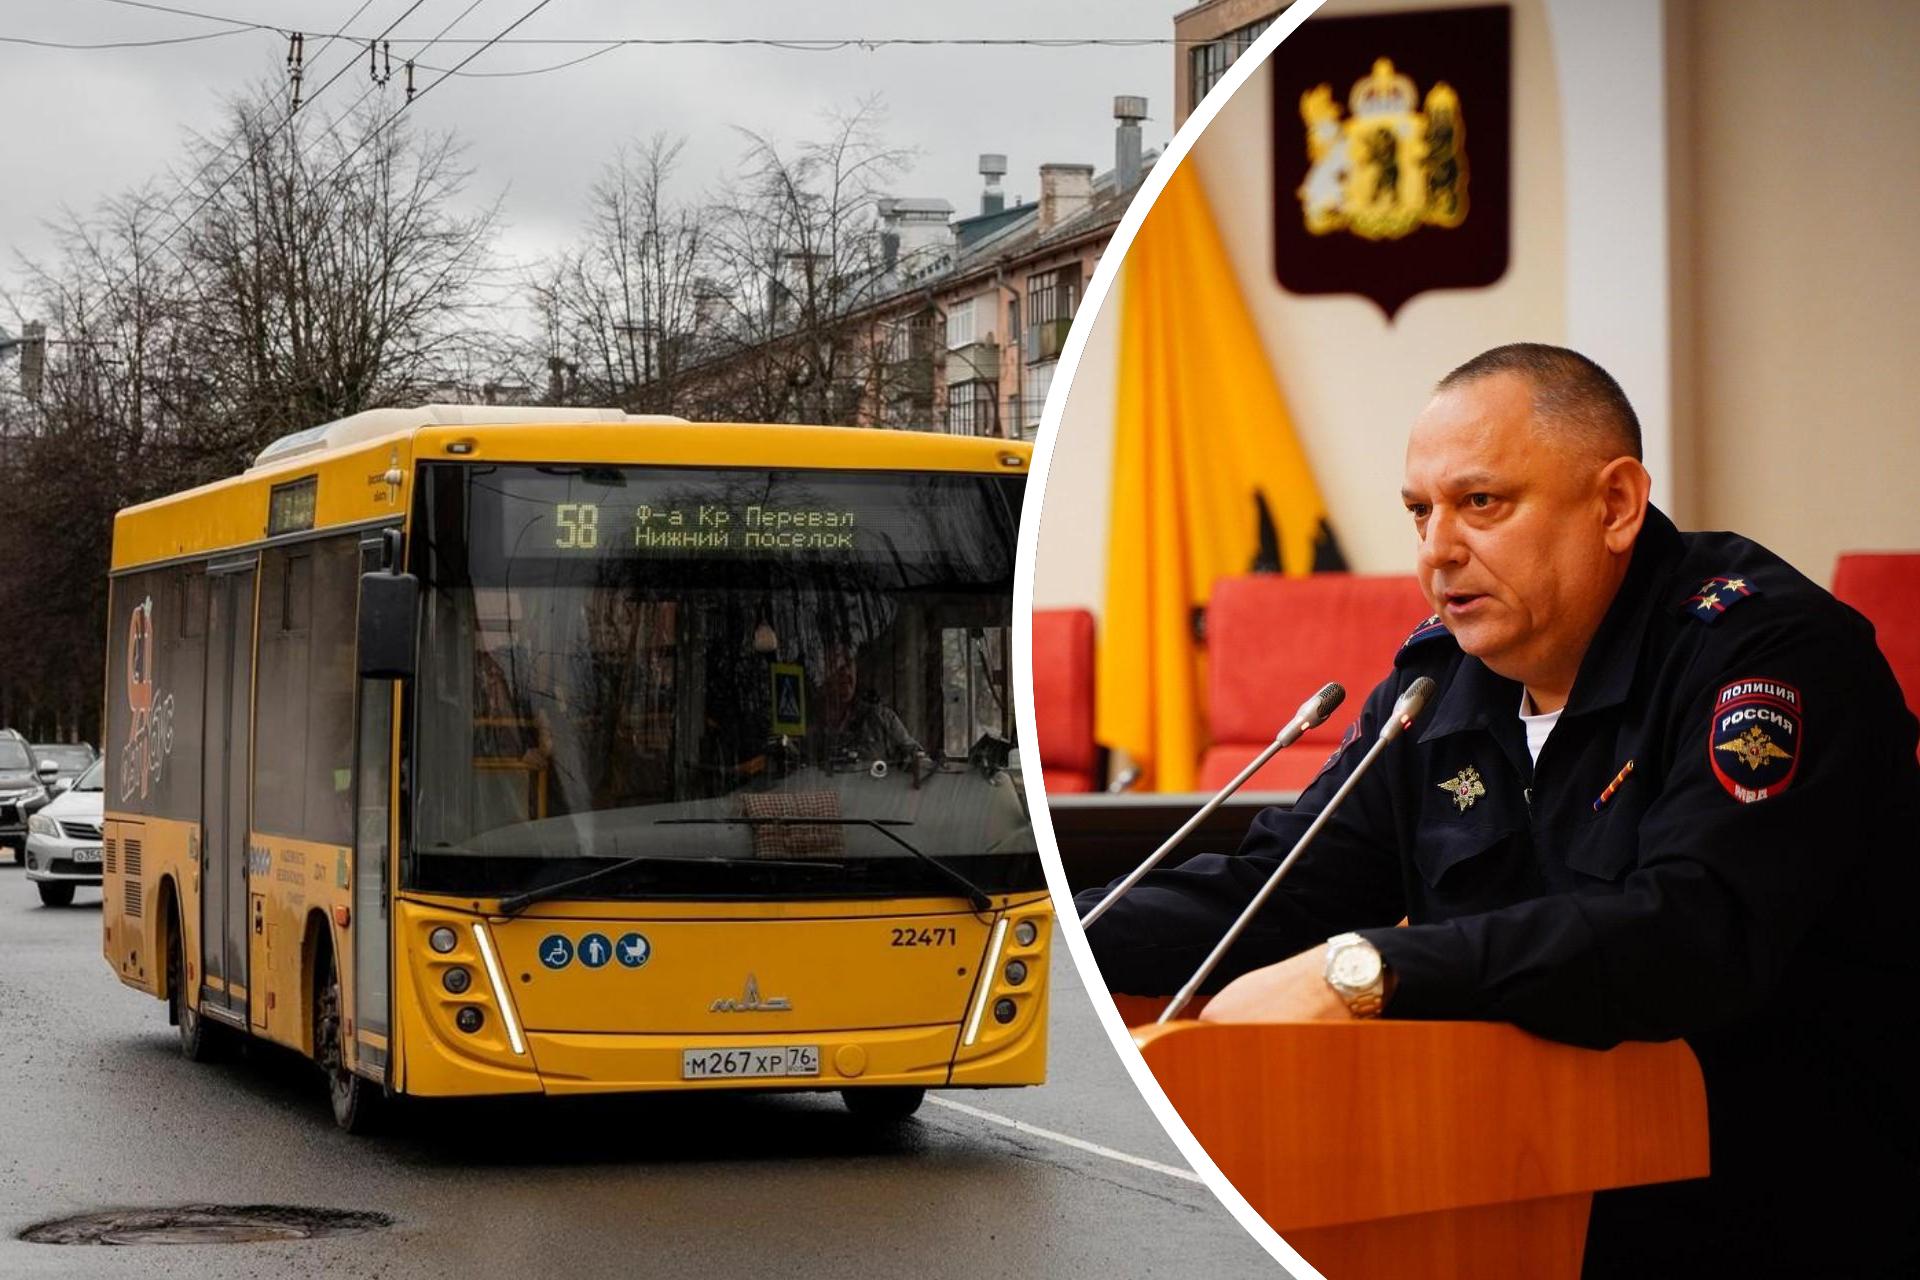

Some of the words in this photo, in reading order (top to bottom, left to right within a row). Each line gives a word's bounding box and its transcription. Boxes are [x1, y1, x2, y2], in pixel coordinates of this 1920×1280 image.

[556, 504, 598, 548] 58
[636, 505, 683, 525] Ф-а
[700, 505, 730, 528] Кр
[747, 506, 854, 528] Перевал
[635, 526, 729, 547] Нижний
[745, 532, 852, 548] поселок
[1722, 683, 1795, 703] ПОЛИЦИЯ
[1722, 709, 1793, 734] РОССИЯ
[1734, 784, 1768, 803] МВД
[891, 928, 956, 946] 22471
[790, 1049, 811, 1065] 76
